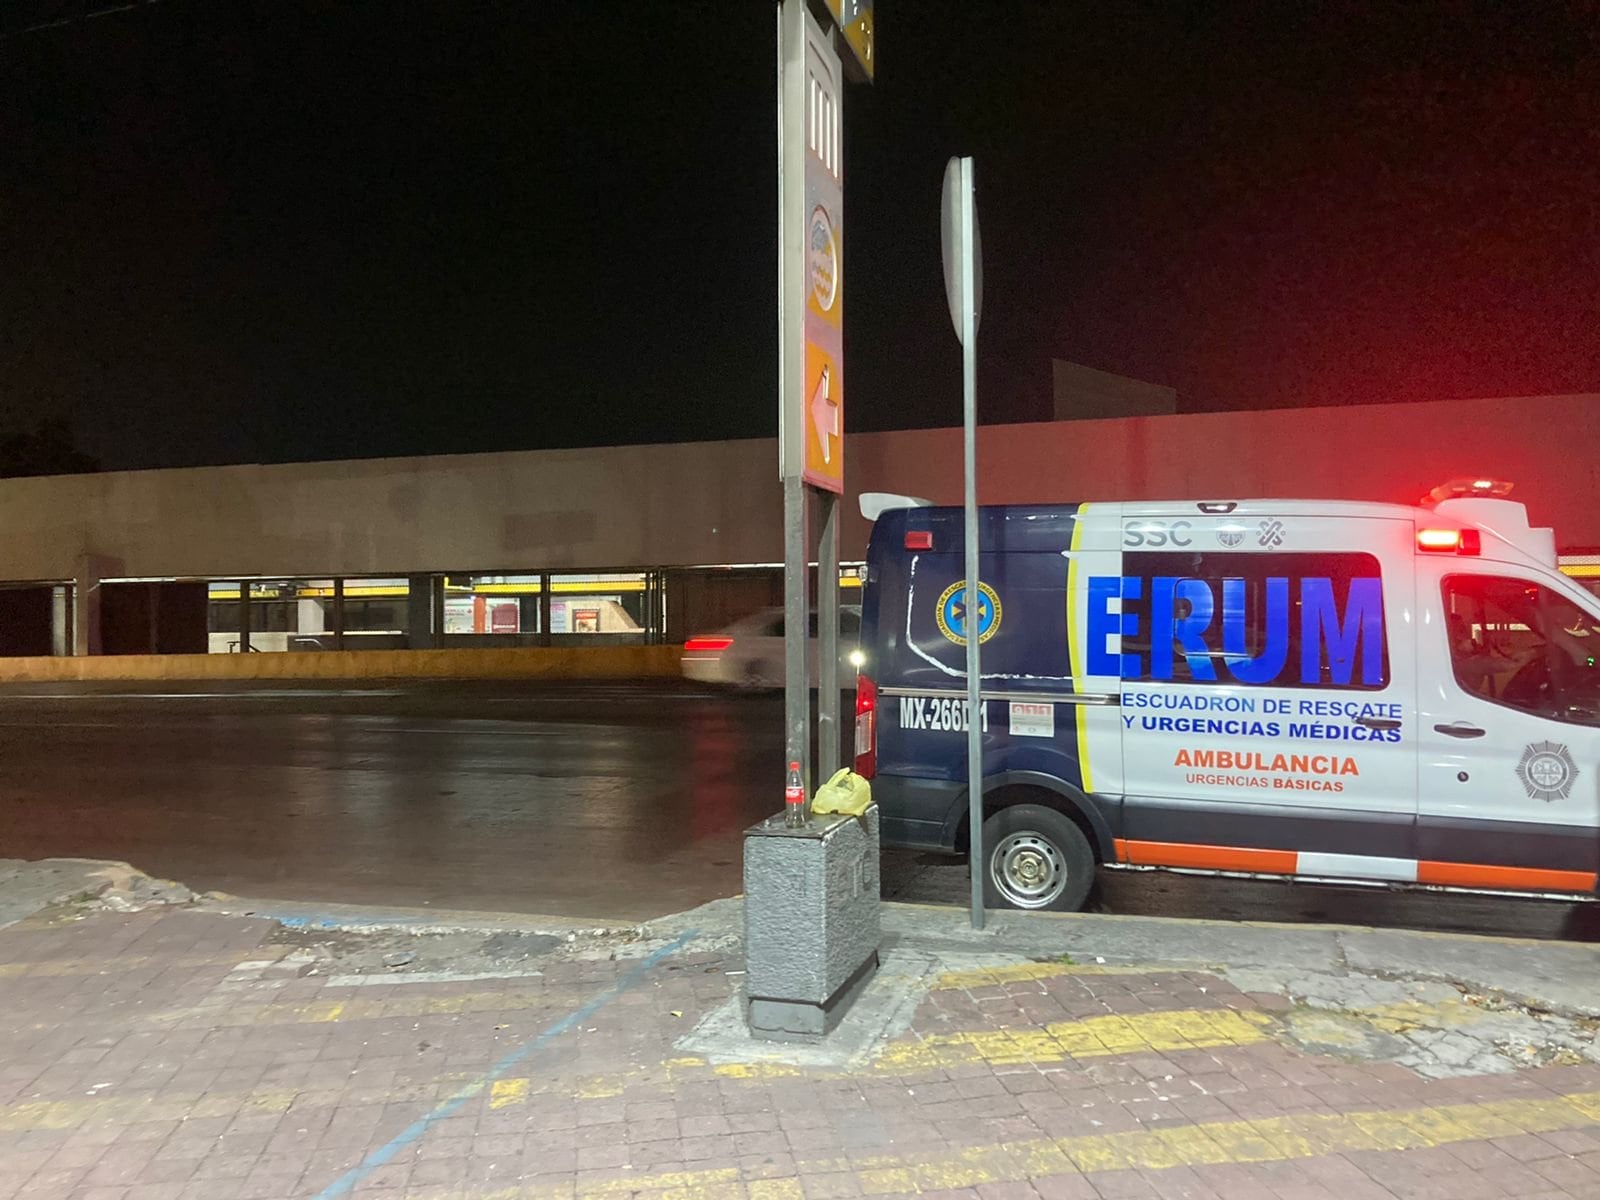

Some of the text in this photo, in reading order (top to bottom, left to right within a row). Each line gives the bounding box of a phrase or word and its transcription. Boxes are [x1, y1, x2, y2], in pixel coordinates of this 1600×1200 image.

[1124, 520, 1193, 547] SSC
[1087, 576, 1384, 686] ERUM
[1122, 692, 1403, 719] ESCUADRON DE RESCATE
[1122, 715, 1402, 742] Y URGENCIAS MÉDICAS
[1174, 749, 1360, 776] AMBULANCIA
[1186, 773, 1344, 792] URGENCIAS BÁSICAS
